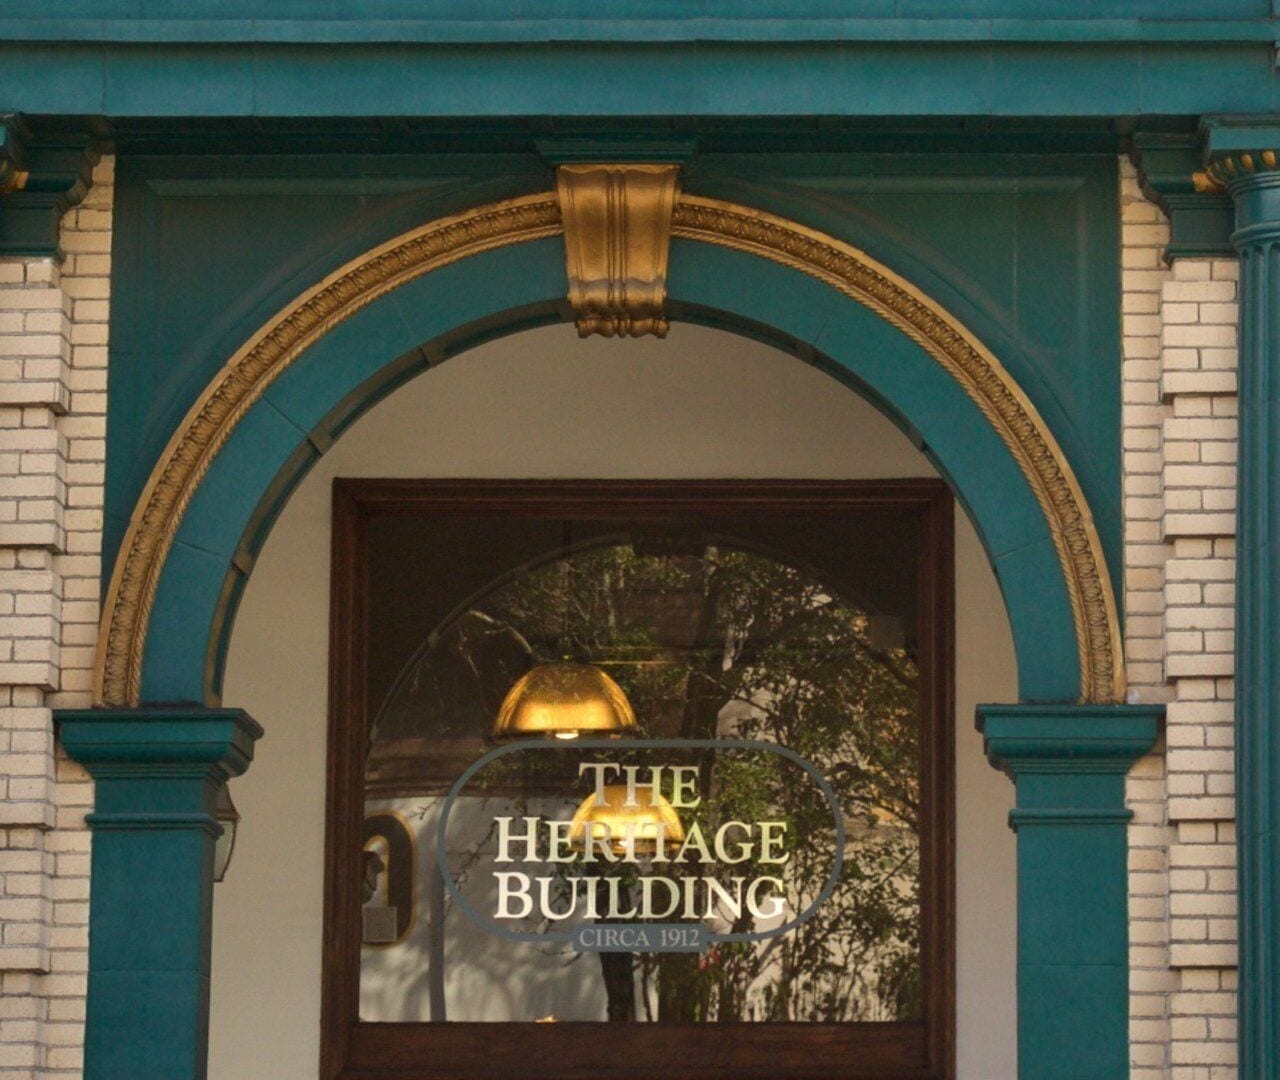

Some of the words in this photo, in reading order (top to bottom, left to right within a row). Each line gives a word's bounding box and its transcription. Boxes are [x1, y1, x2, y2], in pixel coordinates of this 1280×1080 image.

[578, 762, 702, 808] THE
[493, 816, 790, 864] HERITAGE
[493, 871, 788, 921] BUILDING
[578, 928, 650, 947] CIRCA
[660, 928, 700, 947] 1912
